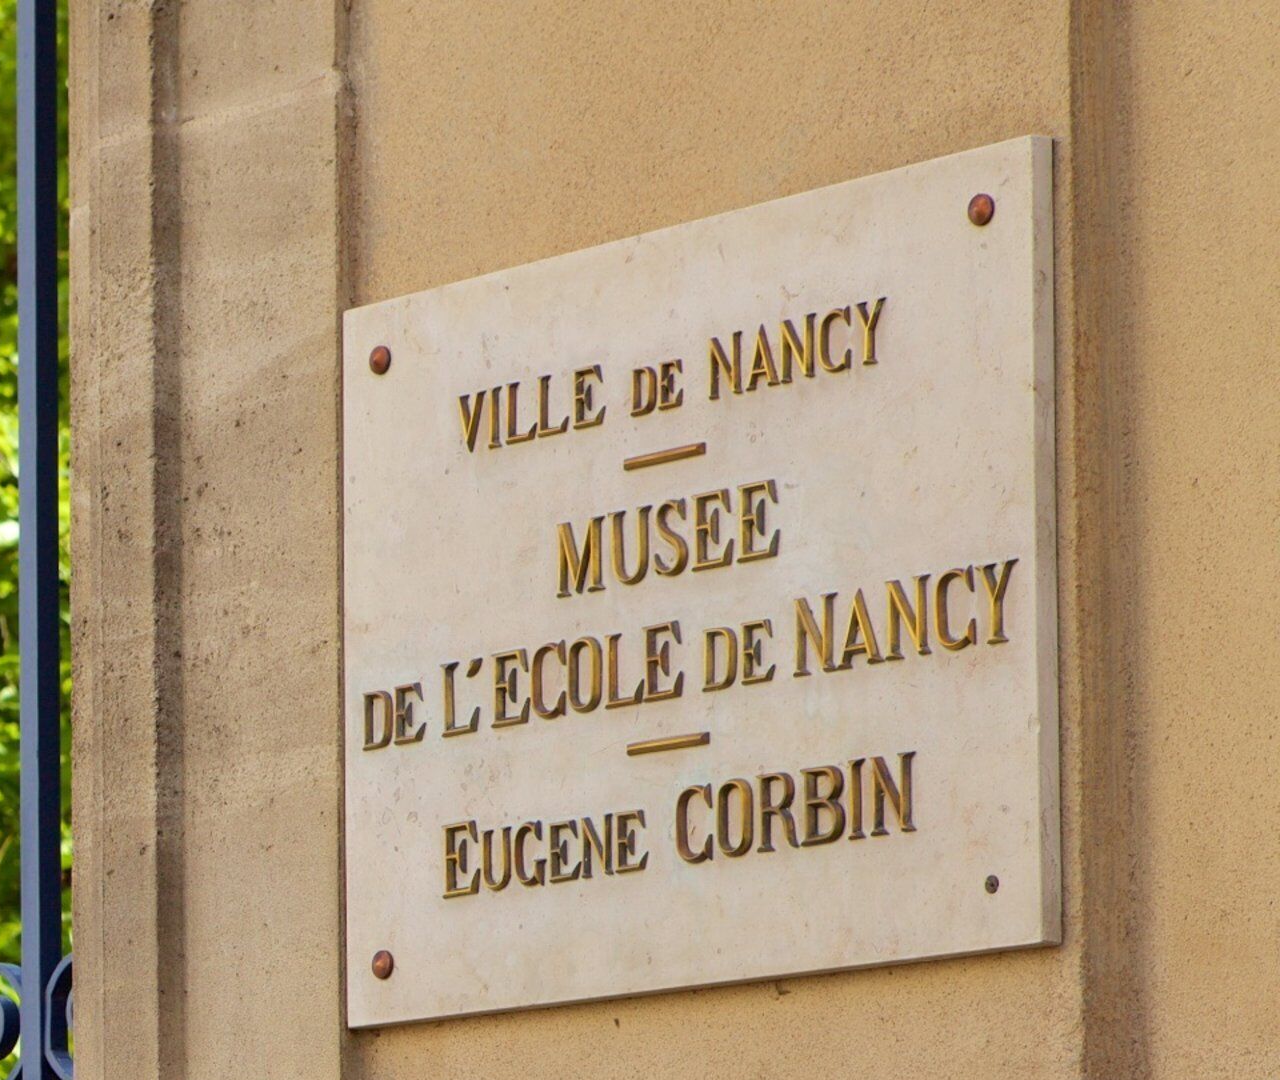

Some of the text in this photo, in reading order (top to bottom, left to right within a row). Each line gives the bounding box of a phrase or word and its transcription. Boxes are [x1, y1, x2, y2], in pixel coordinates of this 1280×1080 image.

[458, 296, 888, 454] VILLE DE NANCY
[556, 478, 781, 599] MUSEE
[362, 558, 1020, 752] DE L'ECOLE DE NANCY
[442, 751, 917, 900] EUGENE CORBIN
